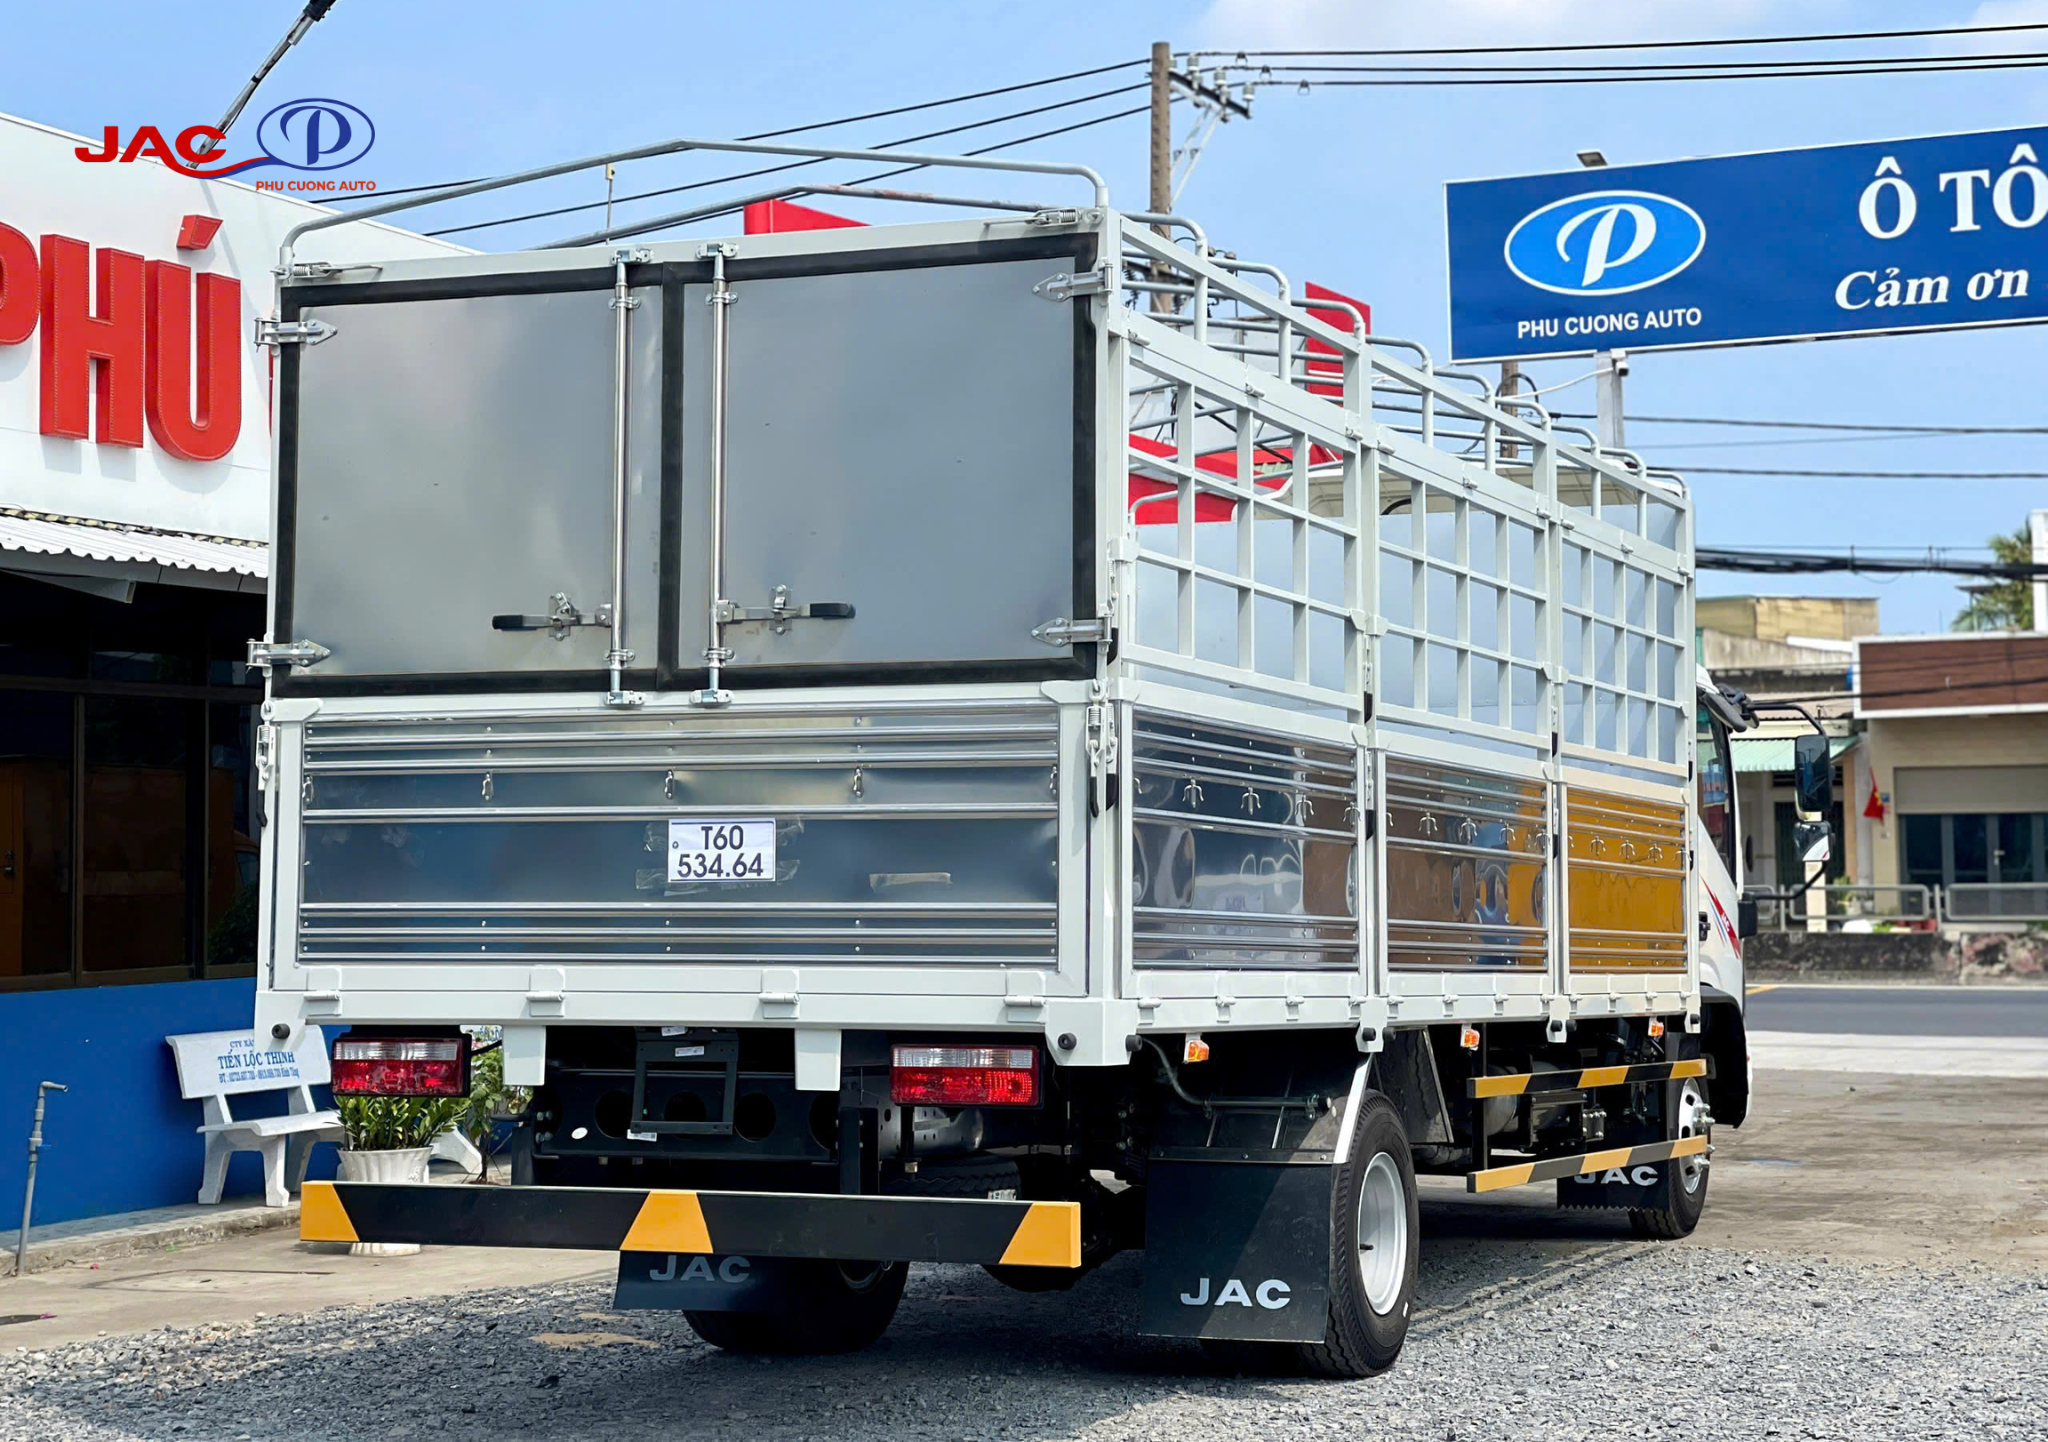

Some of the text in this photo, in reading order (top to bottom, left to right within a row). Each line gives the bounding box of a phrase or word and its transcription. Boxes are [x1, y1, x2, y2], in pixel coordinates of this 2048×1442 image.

[1858, 143, 2048, 239] Ô TÔ
[1835, 267, 2029, 310] Cảm ơn
[1517, 307, 1702, 339] PHU CUONG AUTO
[701, 825, 744, 850] T60
[677, 852, 764, 878] 534.64
[650, 1254, 751, 1283] JAC
[1180, 1277, 1291, 1310] JAC
